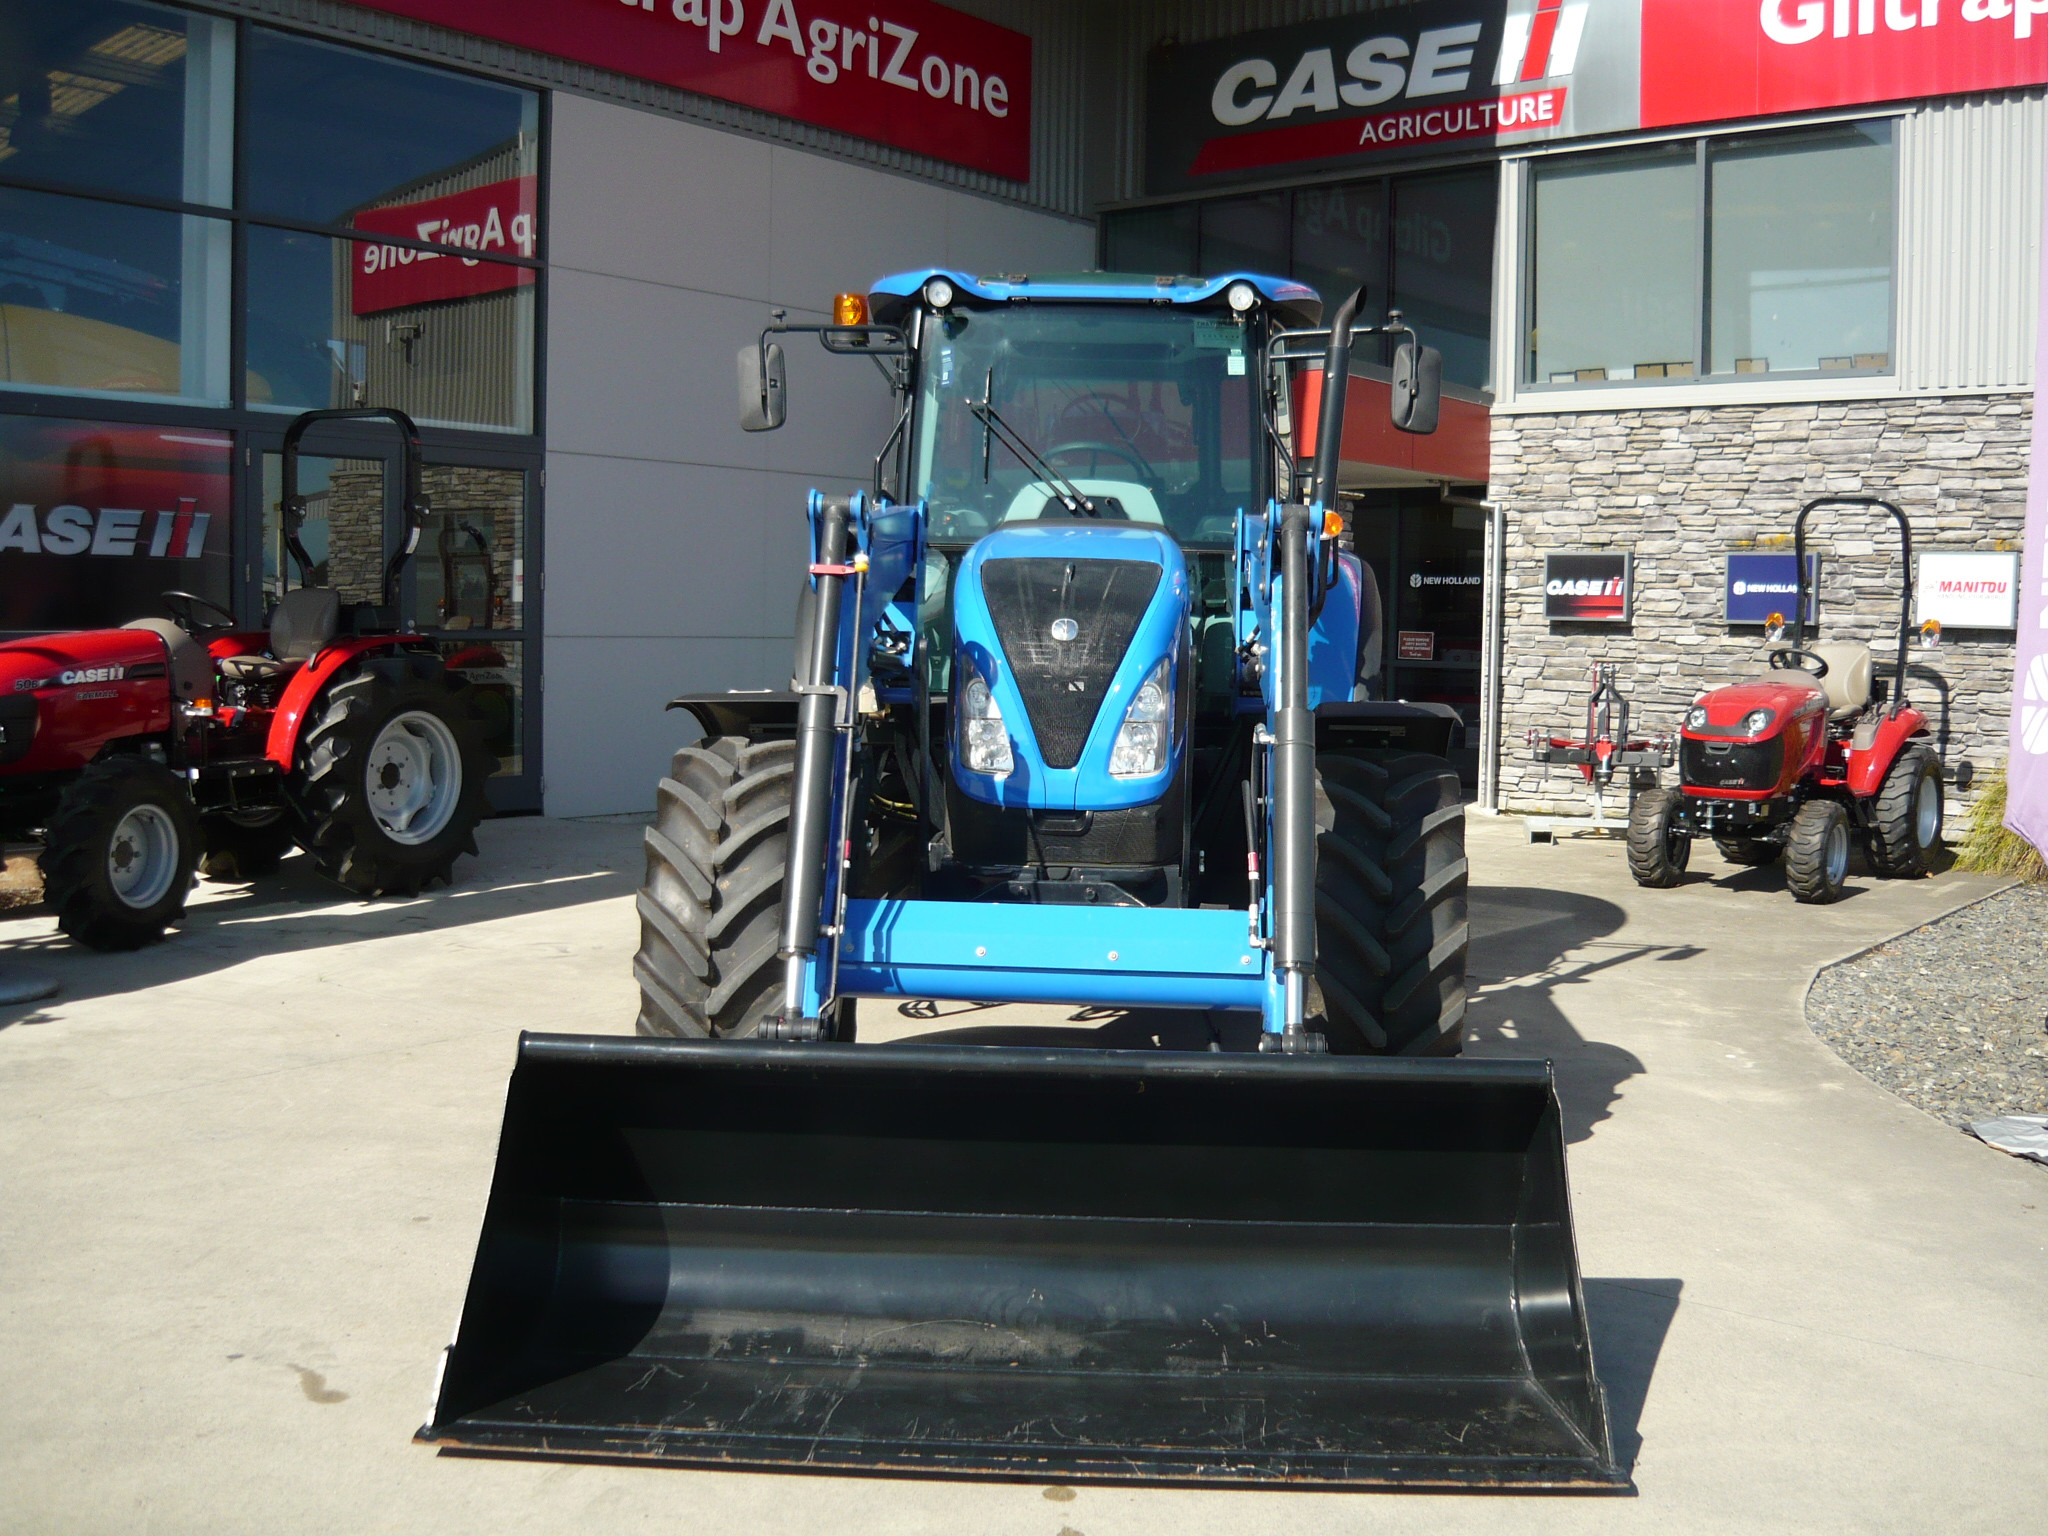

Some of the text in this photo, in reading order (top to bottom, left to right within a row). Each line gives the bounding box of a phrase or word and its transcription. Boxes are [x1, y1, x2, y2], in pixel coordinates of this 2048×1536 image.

[756, 0, 1009, 118] AgriZone
[1211, 22, 1483, 127] CASE
[1358, 94, 1554, 145] AGRICULTURE
[1423, 576, 1481, 585] NEW HOLLAND
[1546, 579, 1604, 596] CASE
[1746, 584, 1766, 593] NEW
[1939, 581, 2007, 593] MANITOU
[61, 668, 109, 685] CASE
